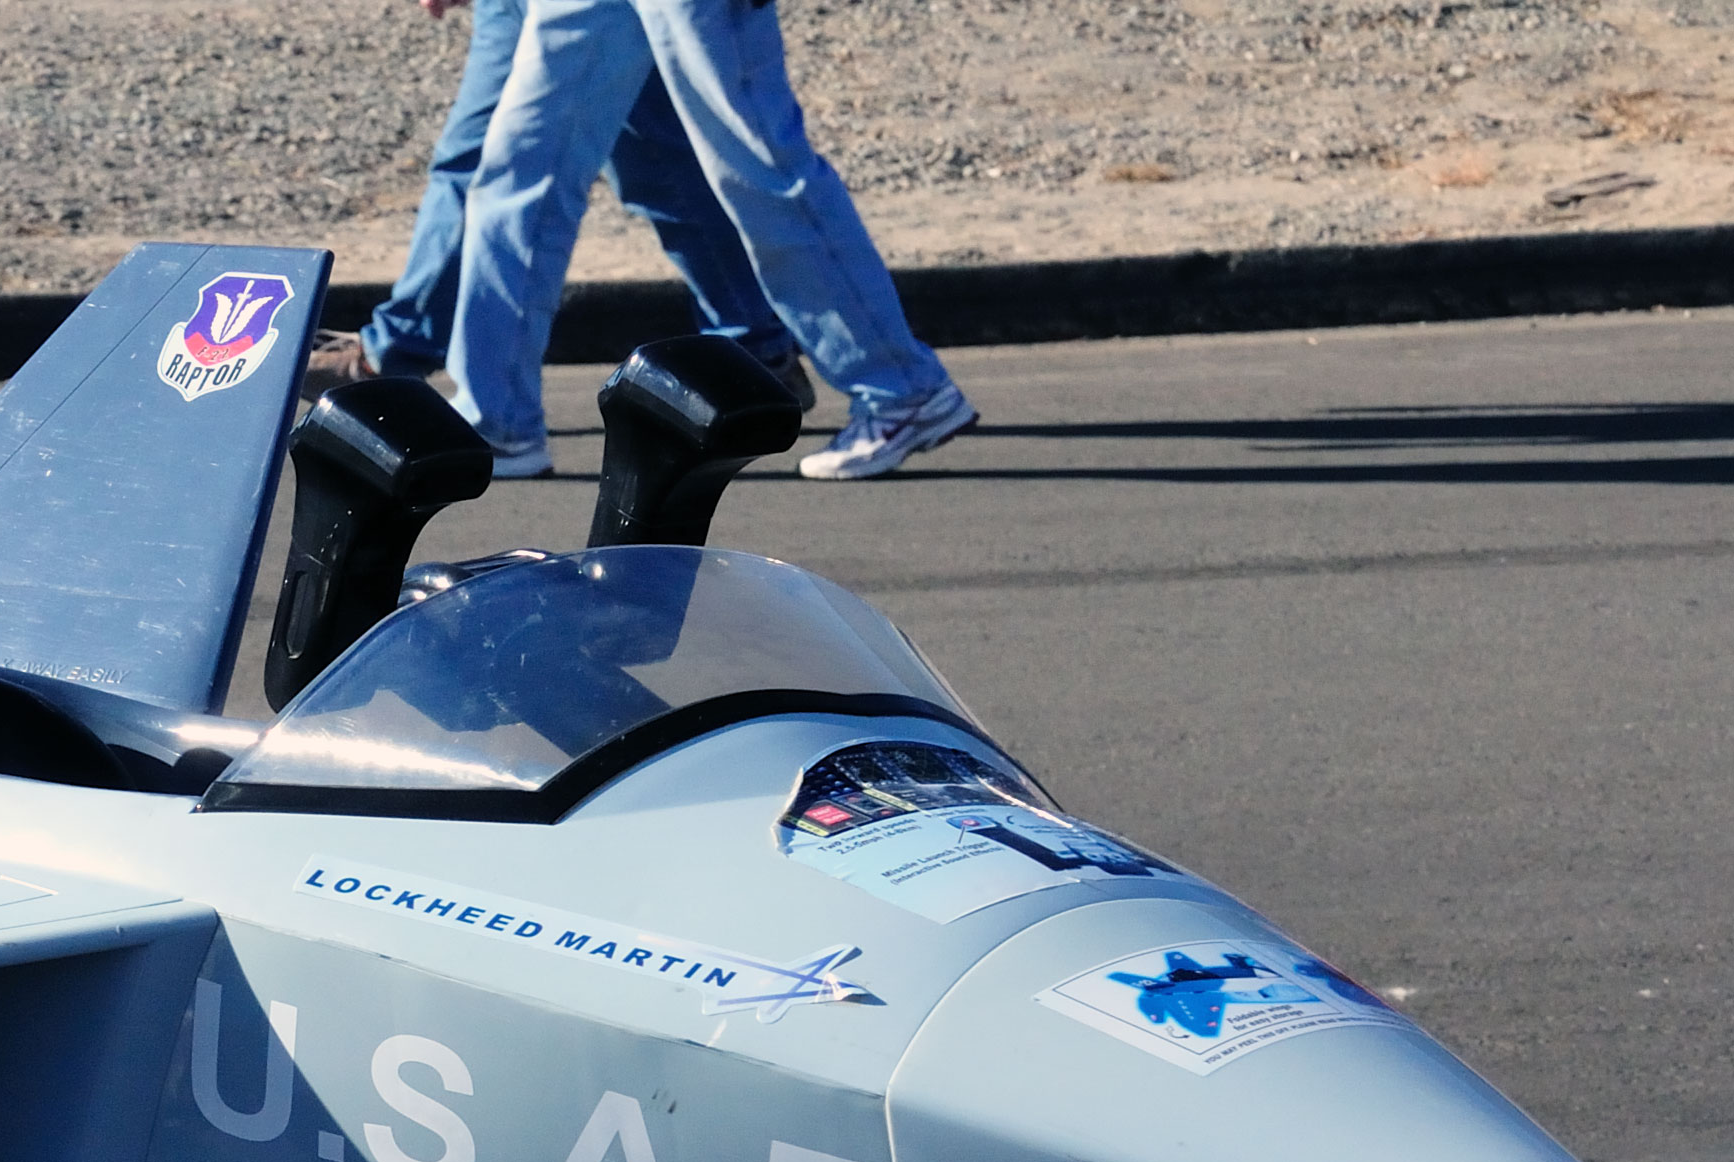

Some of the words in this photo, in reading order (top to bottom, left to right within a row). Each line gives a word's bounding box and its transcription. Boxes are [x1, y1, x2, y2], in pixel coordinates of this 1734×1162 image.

[166, 354, 246, 391] RAPTOR
[21, 660, 64, 679] AWAY
[66, 666, 130, 684] EASILY
[881, 862, 918, 877] Missile
[917, 849, 956, 864] Launch
[305, 869, 544, 939] LOCKHEED
[554, 930, 738, 988] MARTIN
[1226, 1009, 1266, 1024] Foldable
[1267, 1004, 1293, 1012] wings
[1233, 1023, 1248, 1031] for
[1249, 1017, 1272, 1026] easy
[1270, 1010, 1304, 1019] storage
[1205, 1053, 1222, 1064] YOU
